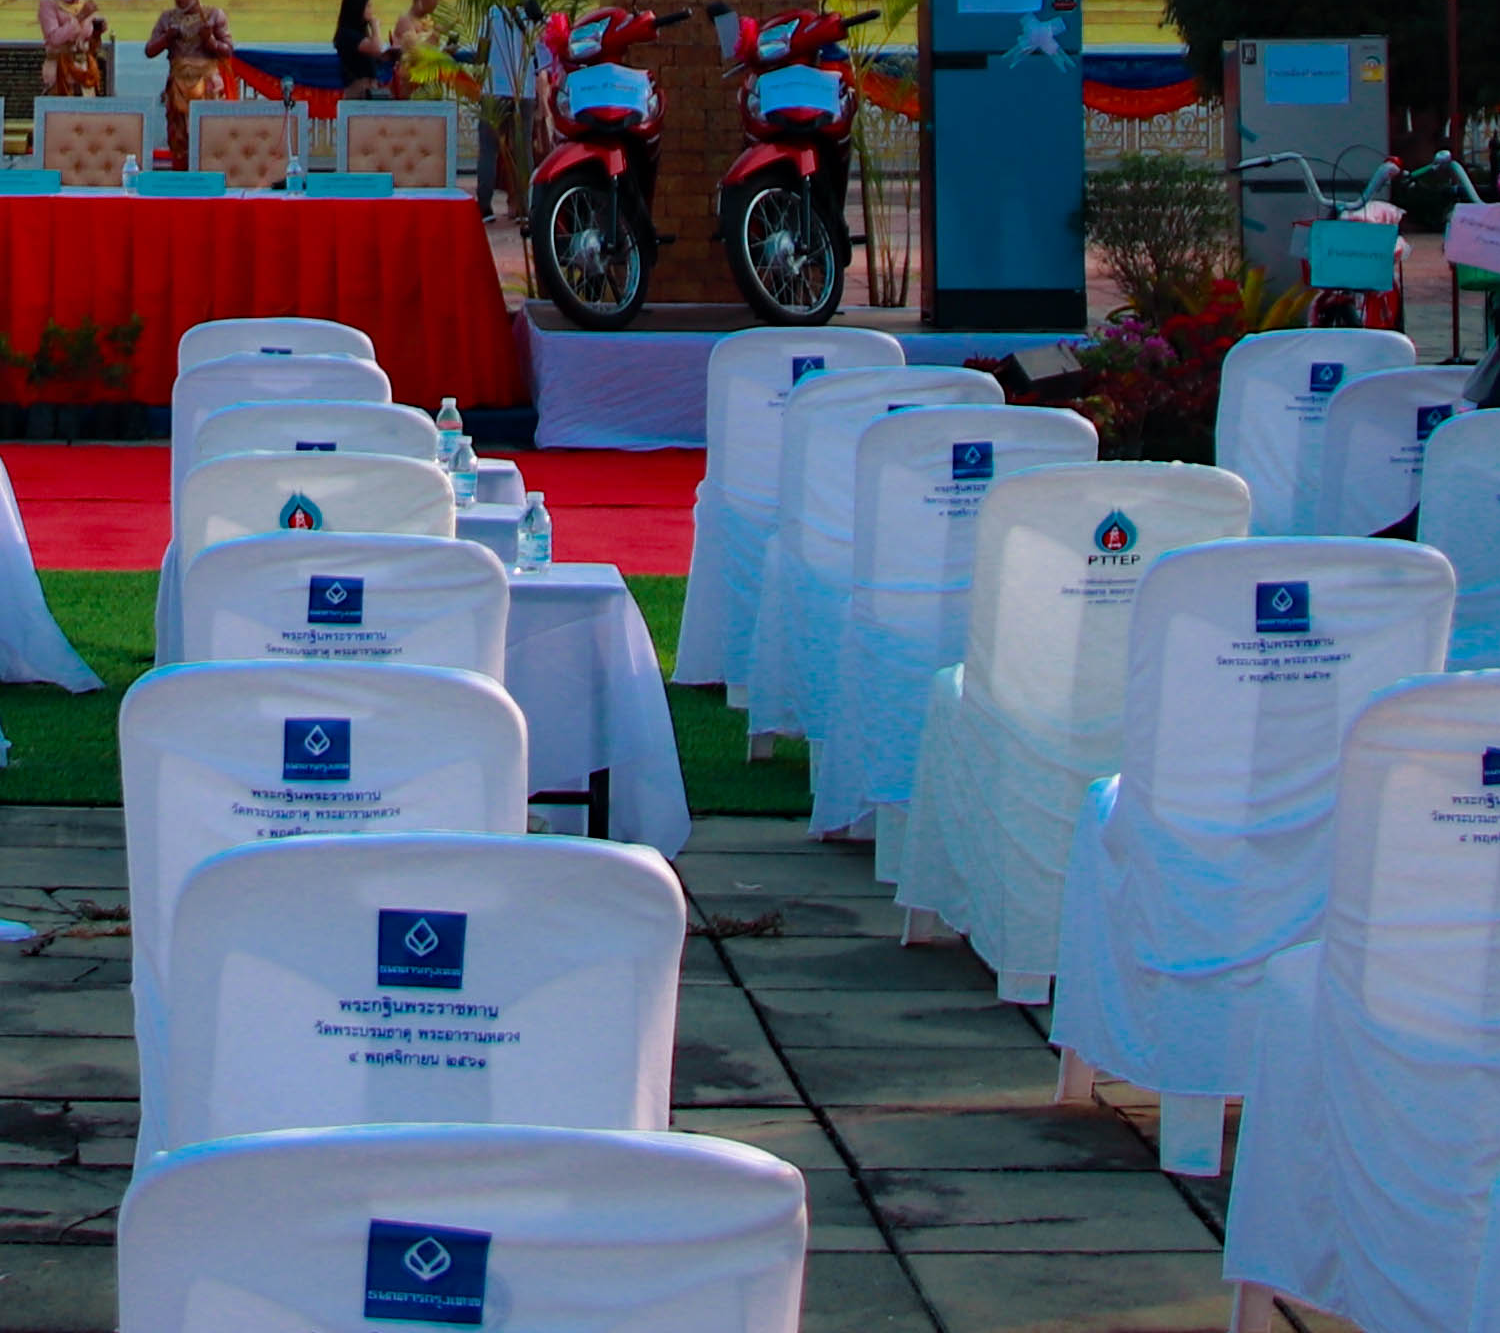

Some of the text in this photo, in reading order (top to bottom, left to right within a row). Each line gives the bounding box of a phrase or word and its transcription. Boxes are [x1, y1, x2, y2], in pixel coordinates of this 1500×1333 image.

[1087, 554, 1141, 566] PTTEP
[282, 628, 387, 644] พระกฐินพระราชทาน
[251, 787, 382, 804] พระกฐินพระราชทาน
[339, 995, 499, 1020] พระกฐินพระราชทาน
[314, 1019, 520, 1043] วัดพระบรมธาตุ พระอารามหลวง
[364, 1049, 439, 1067] พฤศจิกายน
[445, 1054, 487, 1069] ๒๕๖๑
